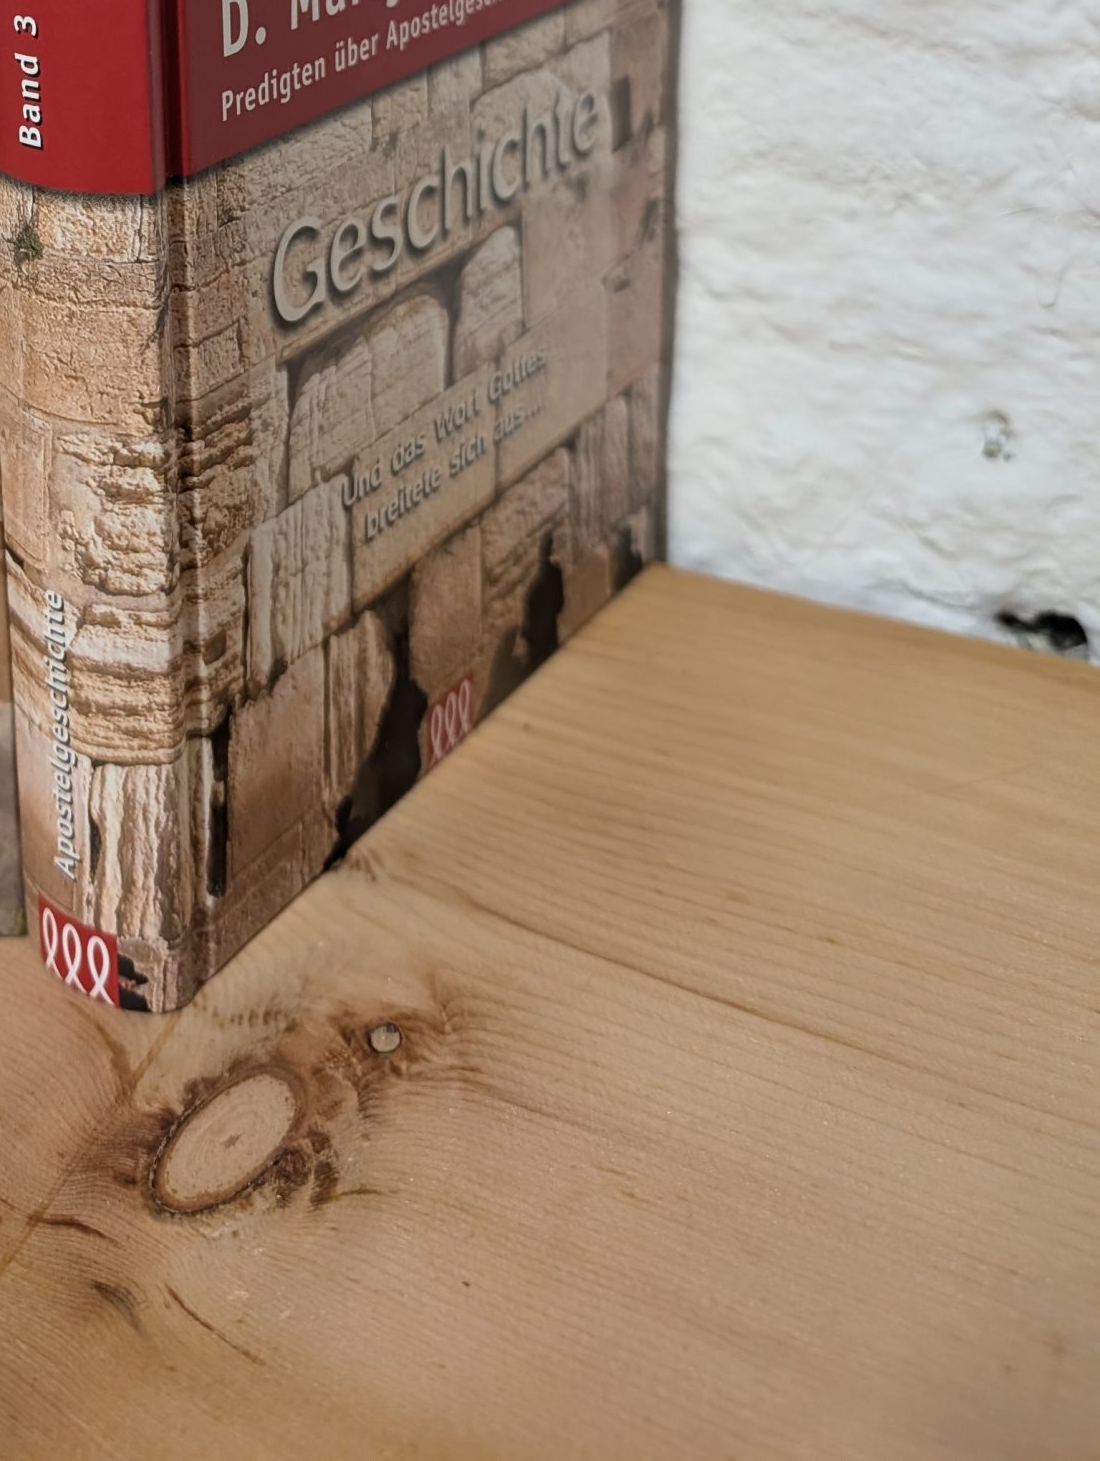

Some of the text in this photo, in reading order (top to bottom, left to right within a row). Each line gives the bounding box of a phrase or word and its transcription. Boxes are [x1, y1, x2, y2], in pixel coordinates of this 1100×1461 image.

[13, 14, 44, 151] Band 3
[221, 54, 327, 122] Predigten
[333, 33, 379, 73] über
[271, 86, 603, 324] Geschichte
[340, 349, 548, 509] Und das Wort Gottes
[363, 465, 442, 543] breitete
[448, 432, 486, 478] sich
[44, 589, 79, 880] Apostelgeschichte
